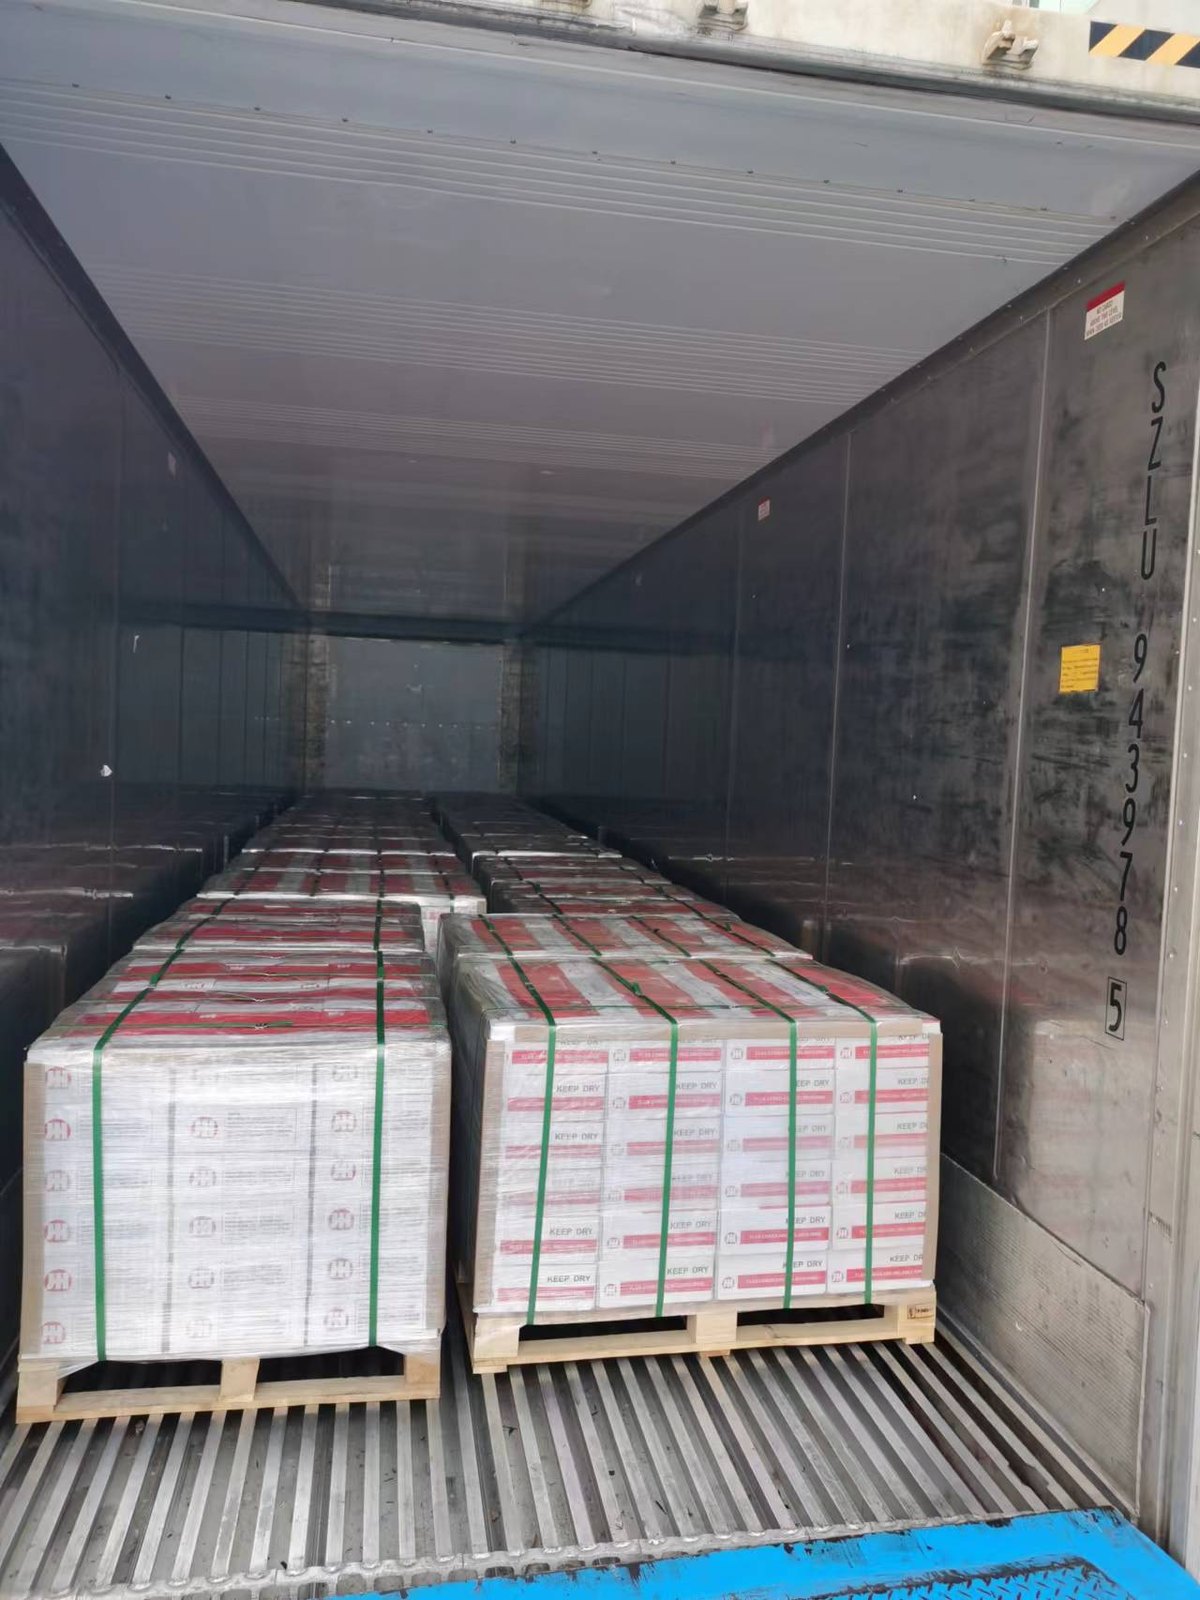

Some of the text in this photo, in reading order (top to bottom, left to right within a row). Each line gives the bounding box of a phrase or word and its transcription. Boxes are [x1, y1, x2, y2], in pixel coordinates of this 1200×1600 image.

[1108, 361, 1166, 1032] SZLU 943978 5
[700, 1081, 718, 1089] DRY
[814, 1079, 830, 1087] DRY
[898, 1077, 917, 1085] KEEP
[556, 1084, 600, 1093] KEEP DRY
[811, 1124, 827, 1132] DRY
[897, 1122, 917, 1130] KEEP
[555, 1131, 598, 1140] KEEP DRY
[674, 1127, 716, 1137] KEEP DRY
[809, 1214, 826, 1223] DRY
[894, 1211, 915, 1219] KEEP
[670, 1220, 712, 1230] KEEP DRY
[549, 1226, 593, 1236] KEEP DRY
[807, 1259, 823, 1268] DRY
[667, 1265, 709, 1276] KEEP DRY
[547, 1273, 591, 1283] KEEP DRY
